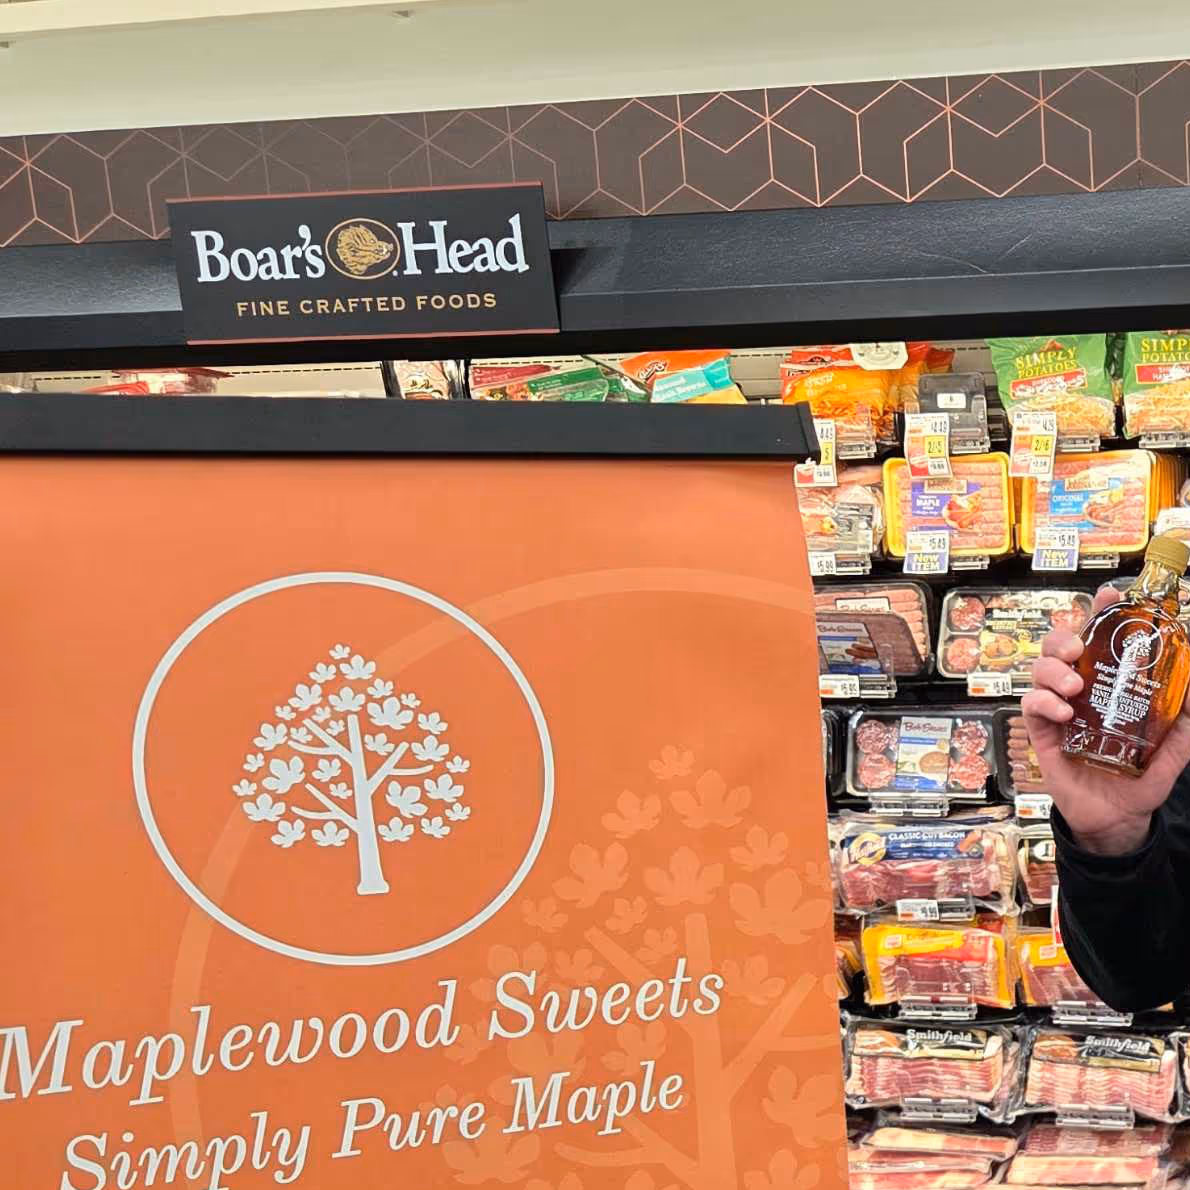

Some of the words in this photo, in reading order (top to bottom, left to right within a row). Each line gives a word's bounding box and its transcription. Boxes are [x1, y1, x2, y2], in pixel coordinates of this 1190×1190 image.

[191, 224, 326, 283] Boar's
[396, 213, 530, 277] Head
[237, 300, 290, 318] FINE
[300, 296, 406, 315] CRAFTED
[416, 293, 497, 311] FOODS
[1015, 347, 1077, 370] SIMPLY
[1018, 360, 1078, 379] POTATOES
[1040, 558, 1069, 568] ITEM
[1042, 550, 1069, 560] New
[1118, 704, 1147, 718] SYRUP
[888, 832, 921, 841] CLASSIC
[938, 831, 966, 839] BACON
[0, 980, 461, 1106] Maplewood
[488, 957, 725, 1042] Sweets
[906, 1028, 973, 1043] Smithfield
[1085, 1035, 1150, 1053] Smithfield
[331, 1097, 487, 1159] Pure
[502, 1060, 684, 1136] Maple
